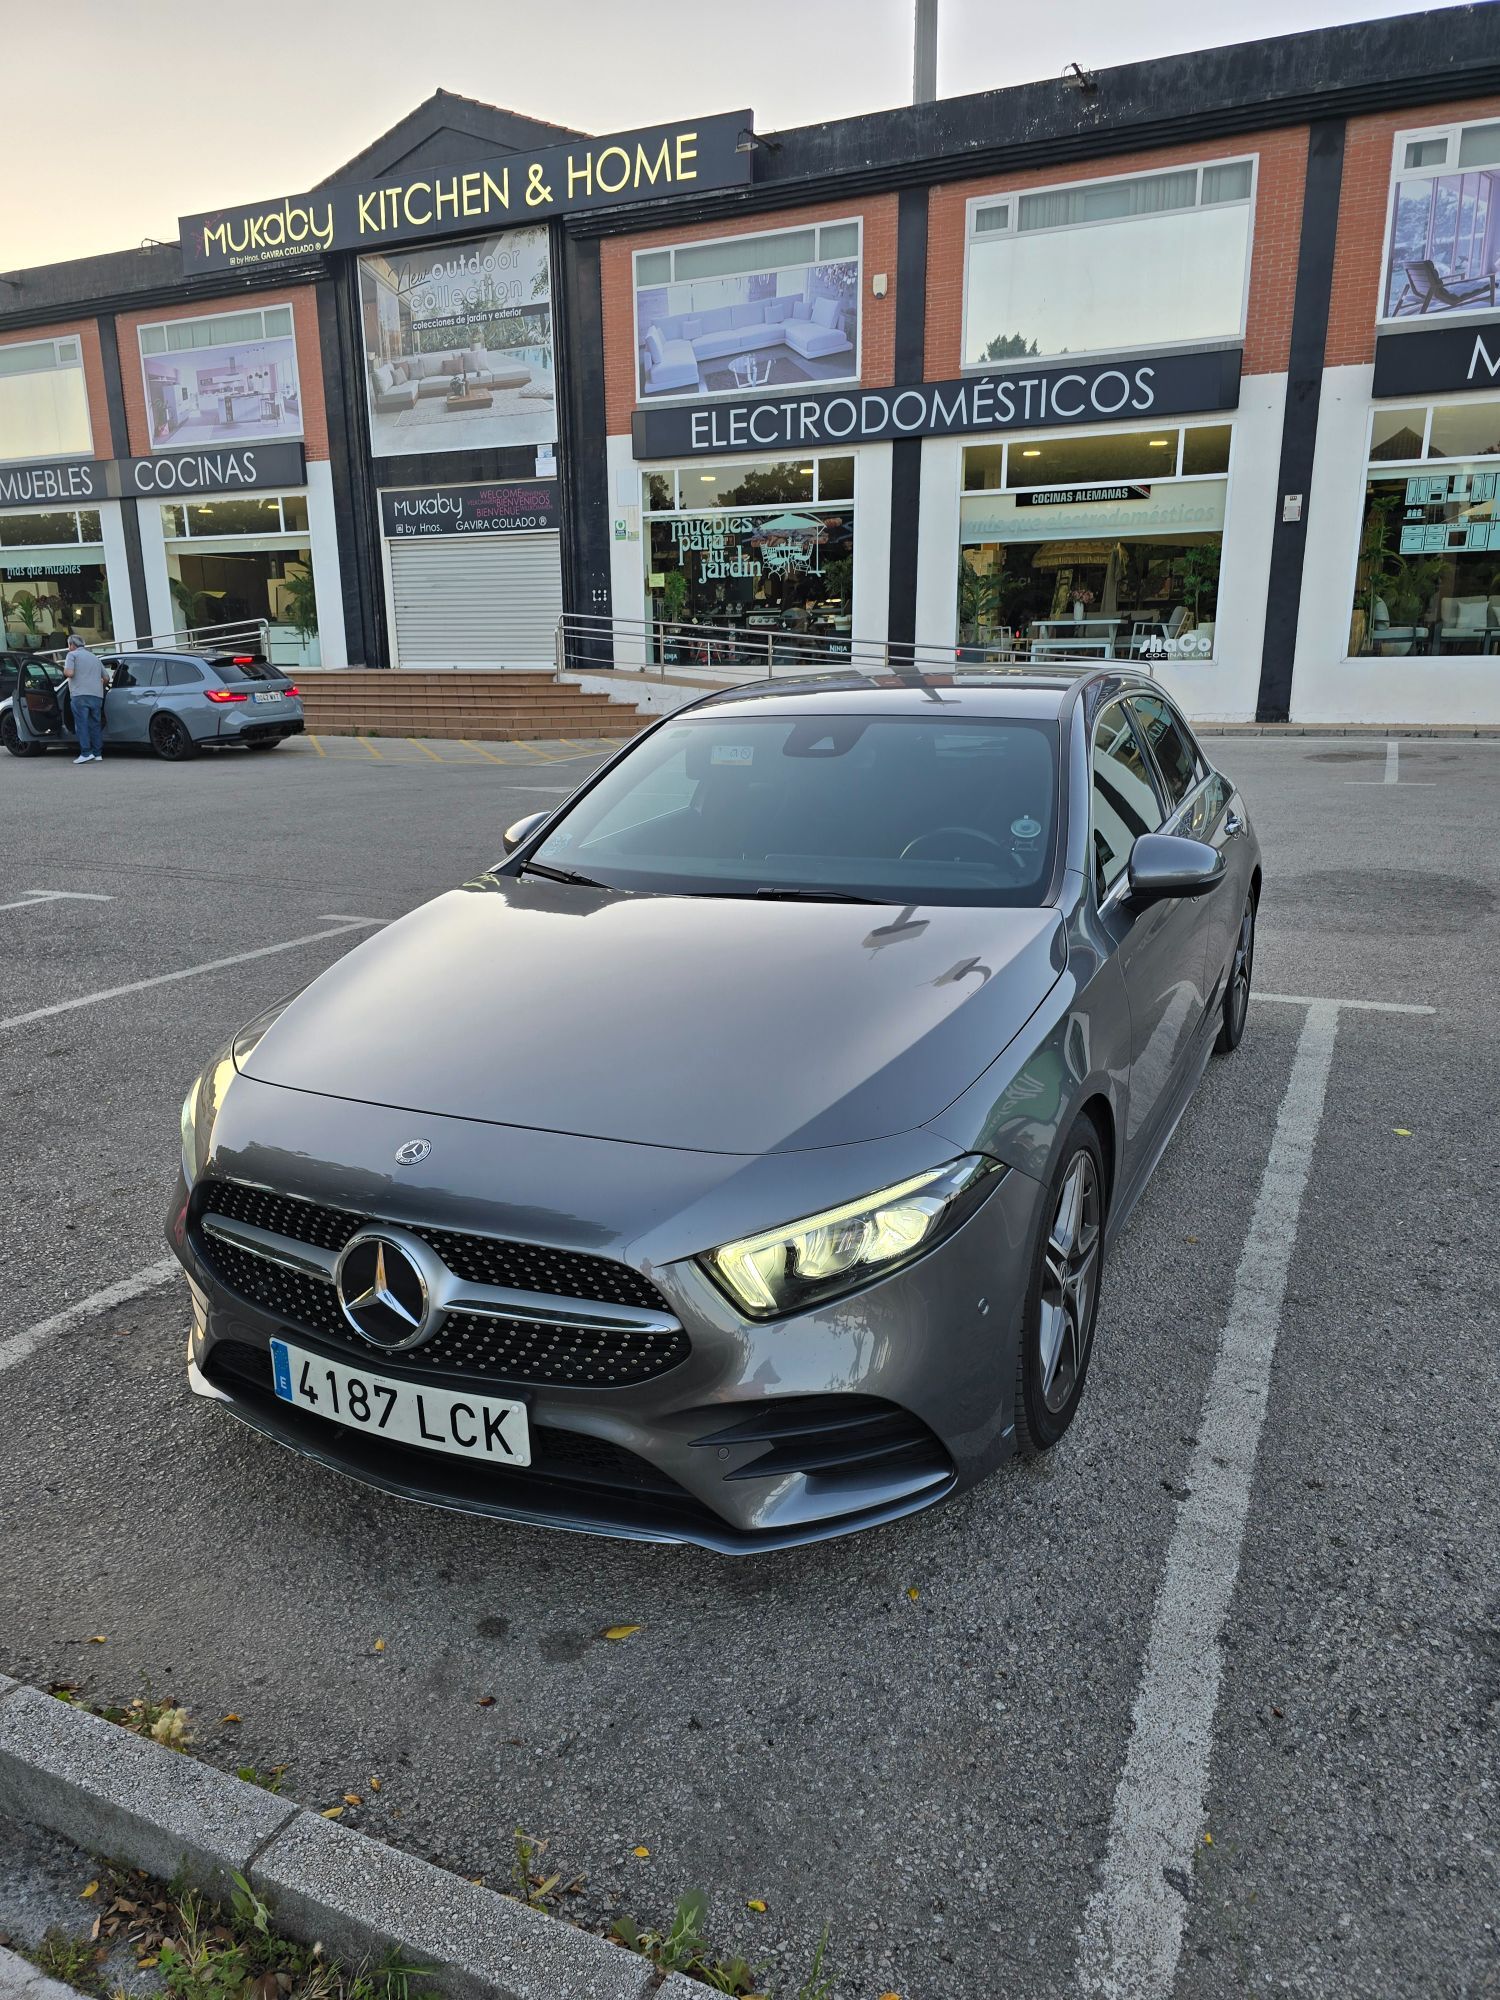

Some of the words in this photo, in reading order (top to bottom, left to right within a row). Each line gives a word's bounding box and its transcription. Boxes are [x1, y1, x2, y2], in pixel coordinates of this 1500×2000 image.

[358, 167, 509, 233] KITCHEN
[525, 163, 553, 206] &
[567, 132, 697, 199] HOME
[236, 256, 244, 265] by
[261, 250, 284, 260] GAVIRA
[284, 244, 314, 256] COLLADO
[388, 262, 430, 295] New
[431, 250, 520, 280] outdoor
[410, 278, 523, 312] collection
[412, 317, 455, 330] colecciones
[456, 315, 465, 325] de
[466, 311, 487, 324] jardín
[494, 308, 522, 319] exterior
[691, 367, 1155, 449] ELECTRODOMÉSTICOS
[0, 466, 93, 500] MUEBLES
[134, 452, 257, 491] COCINAS
[480, 488, 522, 499] WELCOME
[496, 495, 550, 508] BIENVENIDOS
[1032, 492, 1073, 504] COCINAS
[1075, 488, 1129, 501] ALEMANAS
[476, 505, 521, 517] BIENVENUE
[1008, 517, 1042, 534] que
[1046, 503, 1216, 531] electrodomésticos
[406, 524, 417, 534] by
[420, 523, 442, 533] Hnos.
[455, 519, 490, 531] GAVIRA
[491, 517, 536, 529] COLLADO
[670, 516, 753, 542] muebles
[677, 532, 726, 566] para
[708, 547, 725, 563] tu
[27, 565, 43, 579] que
[698, 545, 763, 584] jardín
[830, 644, 848, 653] NINJA
[280, 1375, 288, 1390] E
[299, 1360, 398, 1429] 4187
[416, 1394, 514, 1455] LCK
